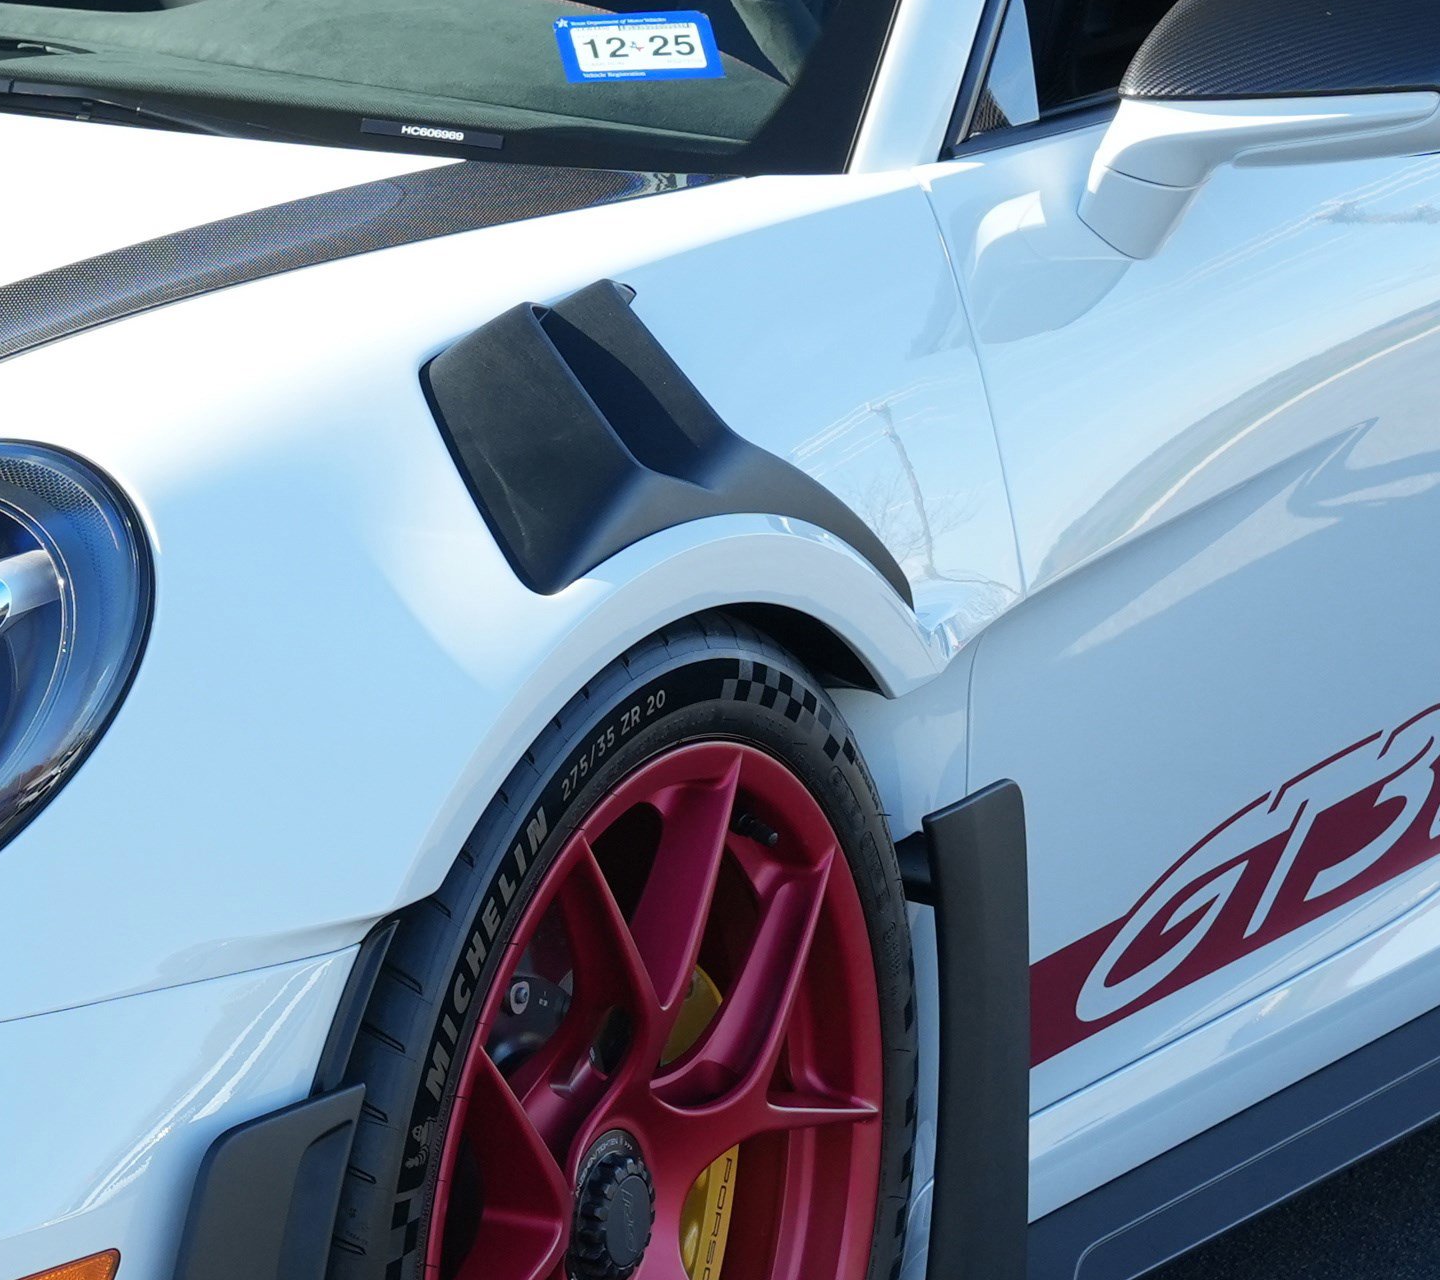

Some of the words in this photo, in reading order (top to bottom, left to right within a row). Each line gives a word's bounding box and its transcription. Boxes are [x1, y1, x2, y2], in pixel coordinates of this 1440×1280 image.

[583, 37, 629, 59] 12
[648, 34, 695, 57] 25
[425, 805, 550, 1099] MICHELIN
[561, 725, 615, 802] 275/35
[620, 705, 642, 736] ZR
[646, 689, 666, 716] 20
